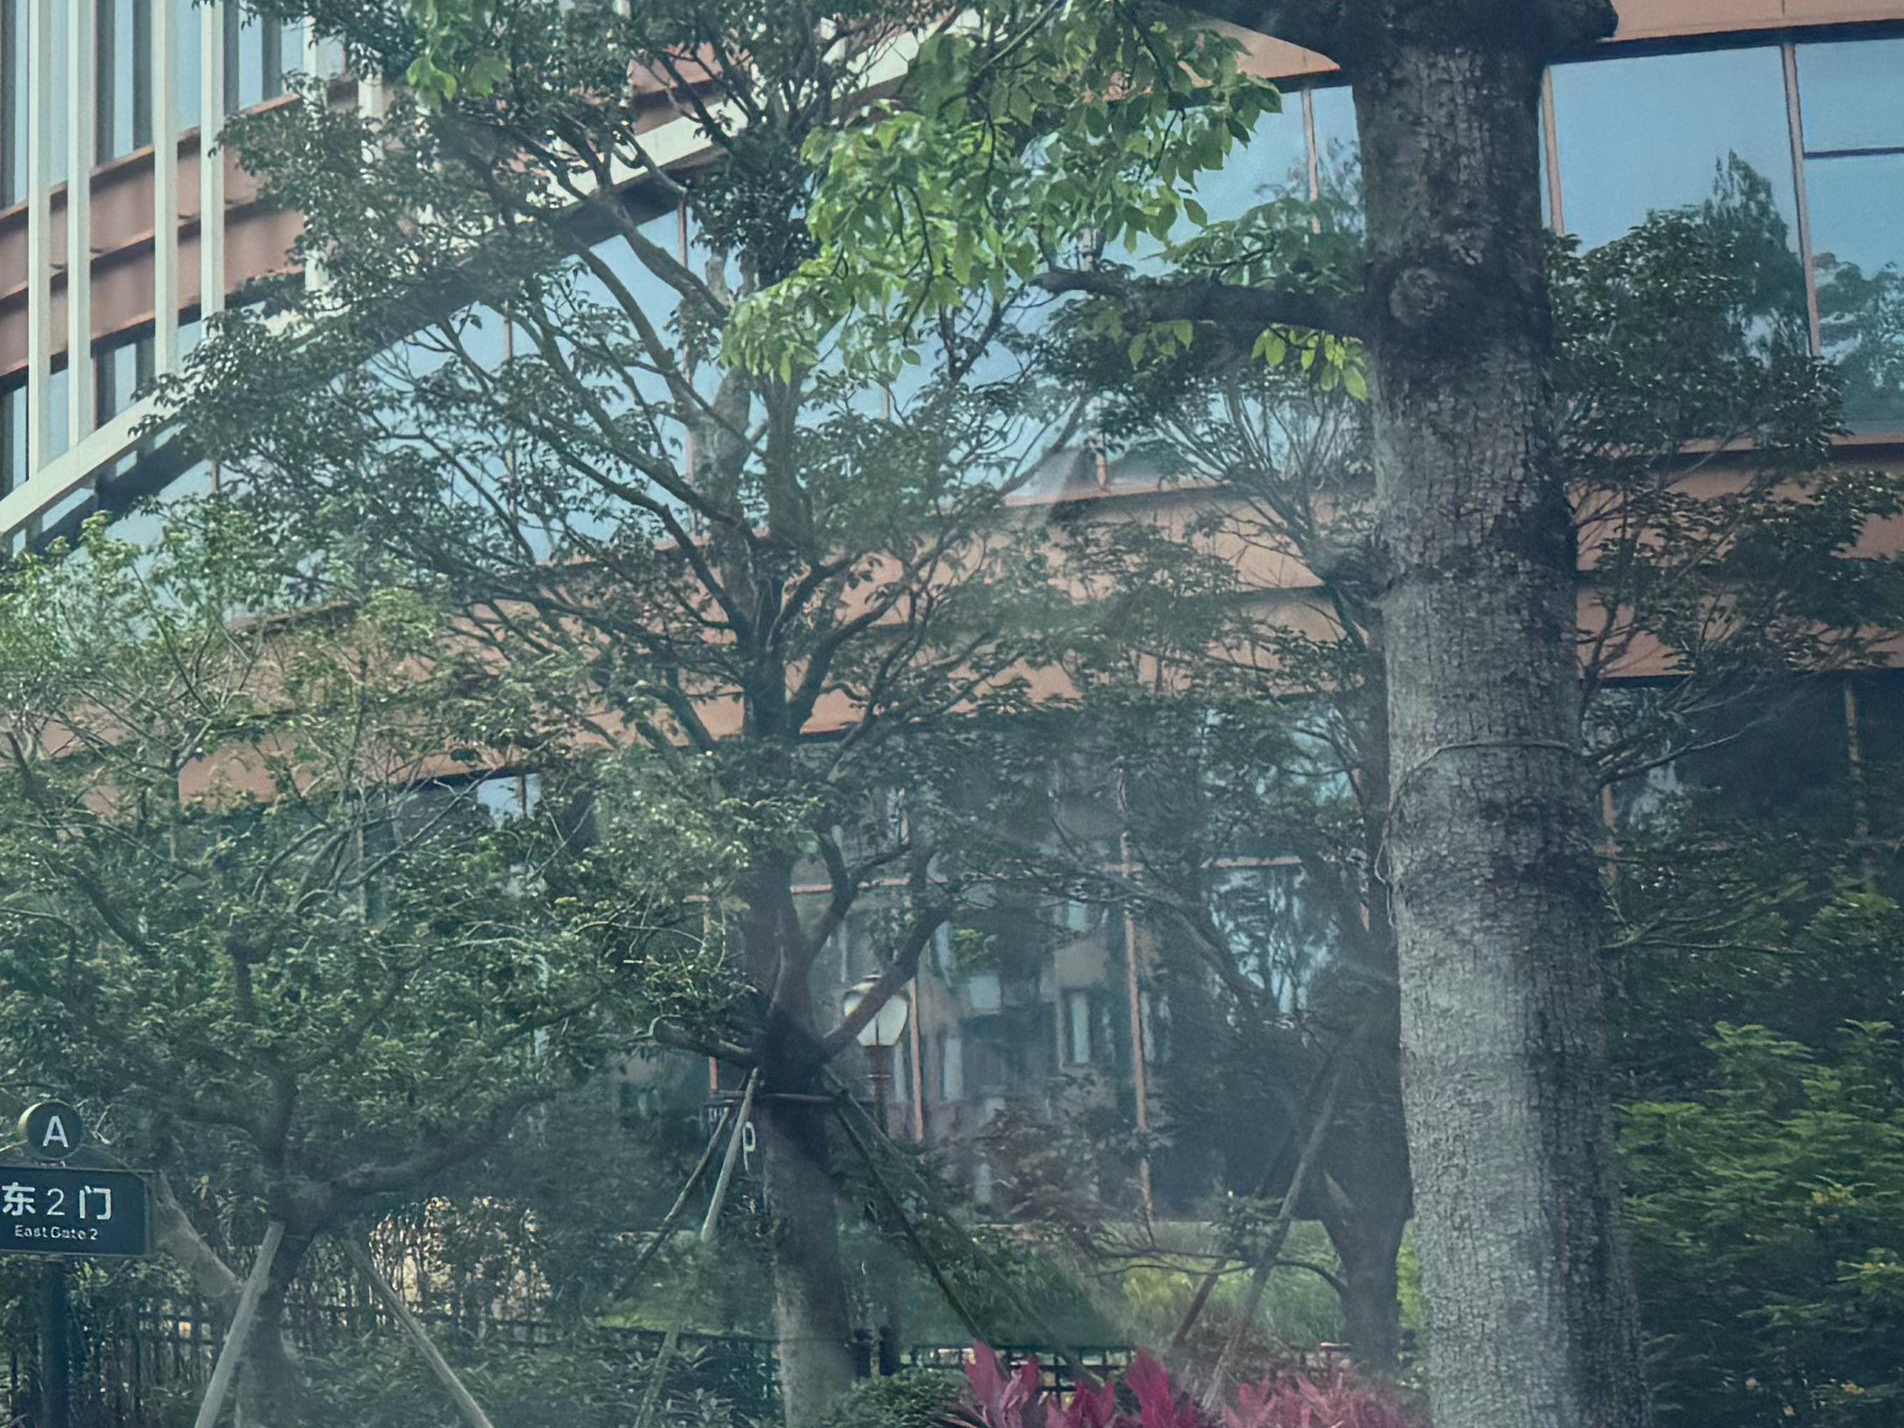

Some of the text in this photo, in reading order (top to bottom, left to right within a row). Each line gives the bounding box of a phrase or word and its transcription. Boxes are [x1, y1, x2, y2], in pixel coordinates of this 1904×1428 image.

[42, 1115, 69, 1148] A
[1, 1181, 112, 1220] 东2门
[14, 1224, 98, 1241] East Gate 2
